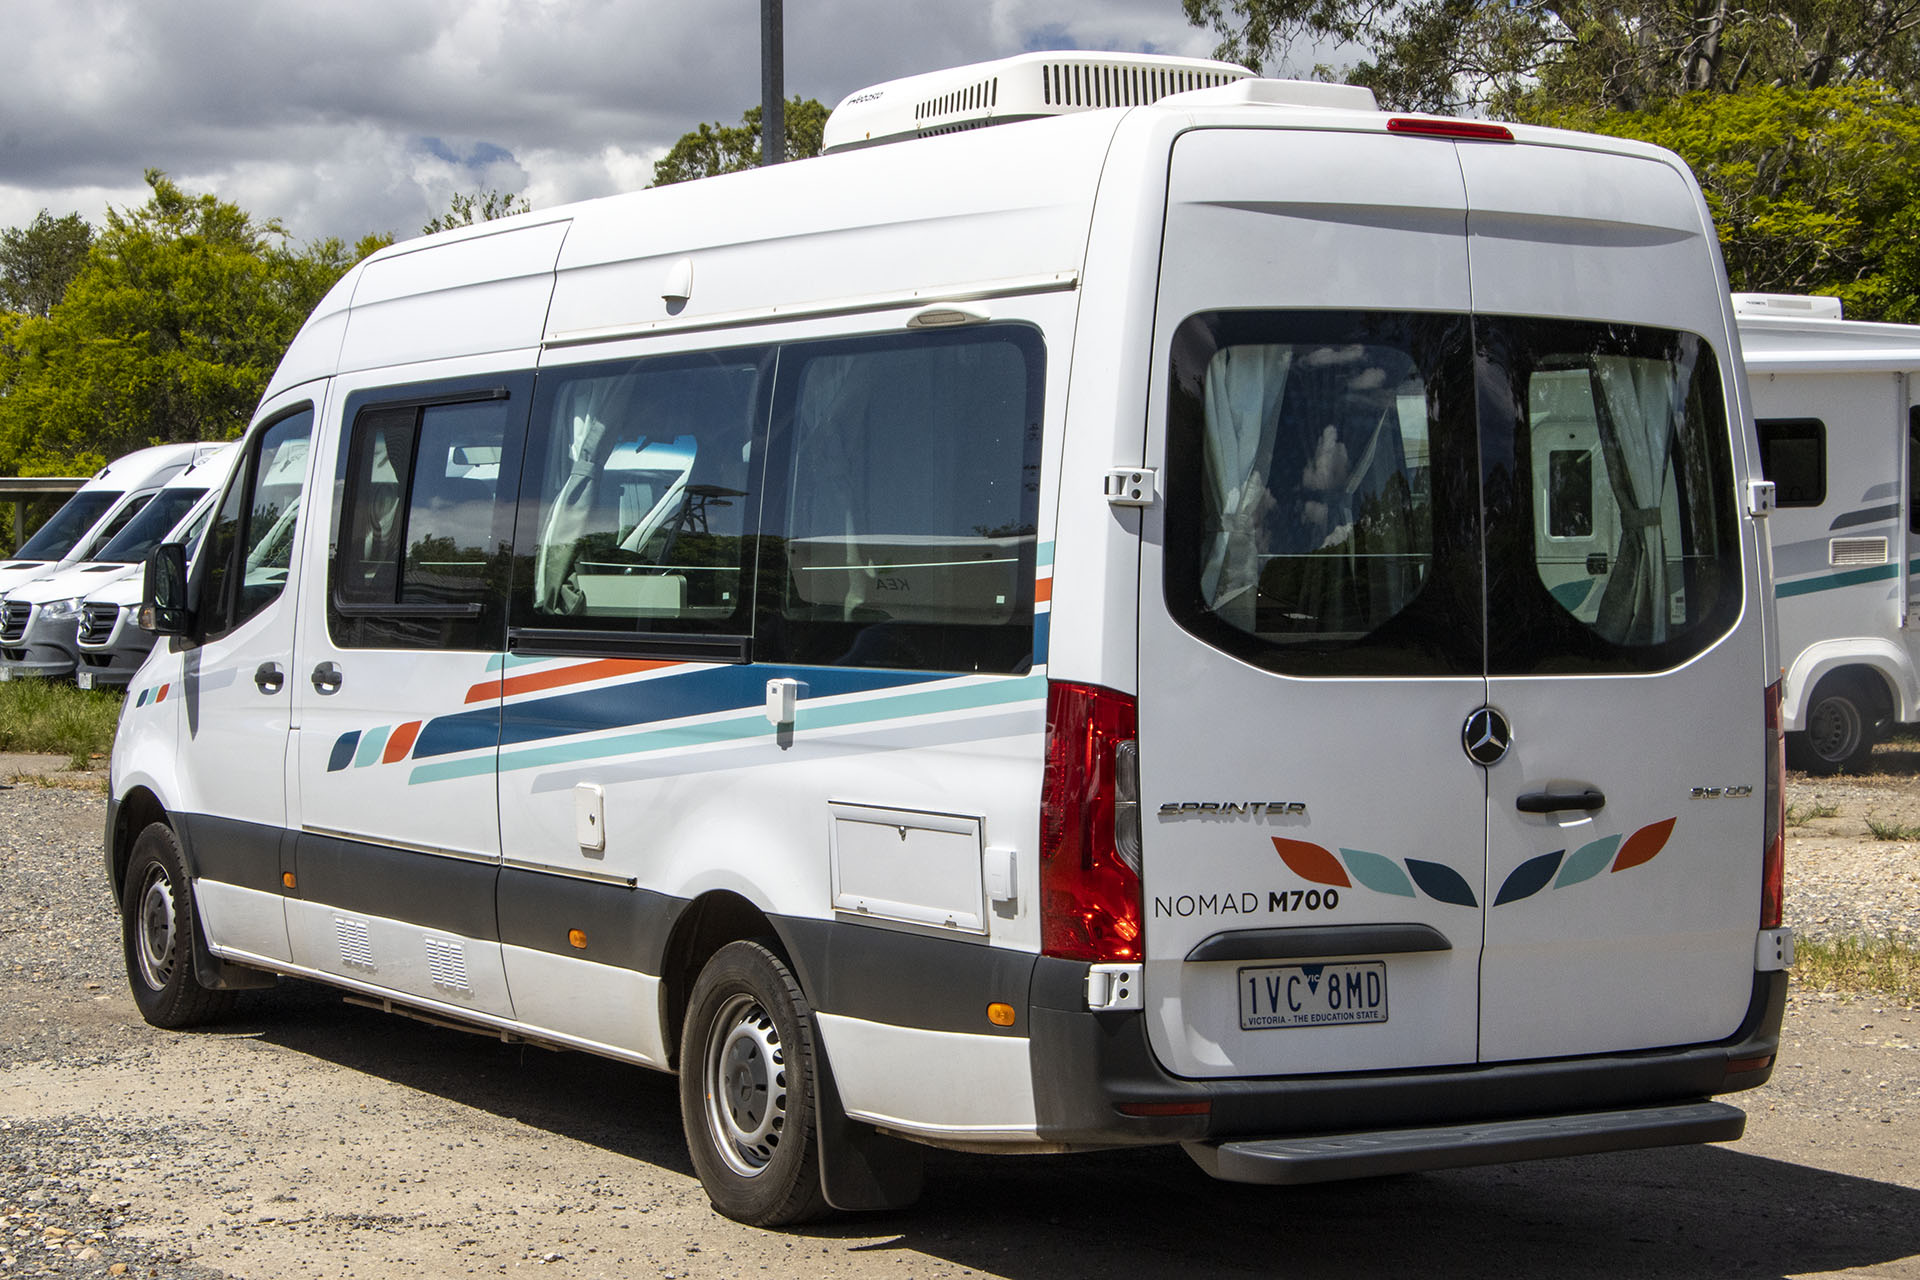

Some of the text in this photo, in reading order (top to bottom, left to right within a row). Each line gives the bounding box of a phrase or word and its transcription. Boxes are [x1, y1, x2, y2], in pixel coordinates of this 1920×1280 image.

[1157, 801, 1307, 816] SPRINTER
[1154, 888, 1339, 918] NOMAD M700
[1305, 974, 1321, 983] VIC
[1248, 971, 1381, 1015] 1VC 8MD
[1248, 1015, 1287, 1026] VICTORIA
[1293, 1014, 1309, 1023] THE
[1310, 1012, 1354, 1022] EDUCATION
[1356, 1010, 1379, 1020] STATE
